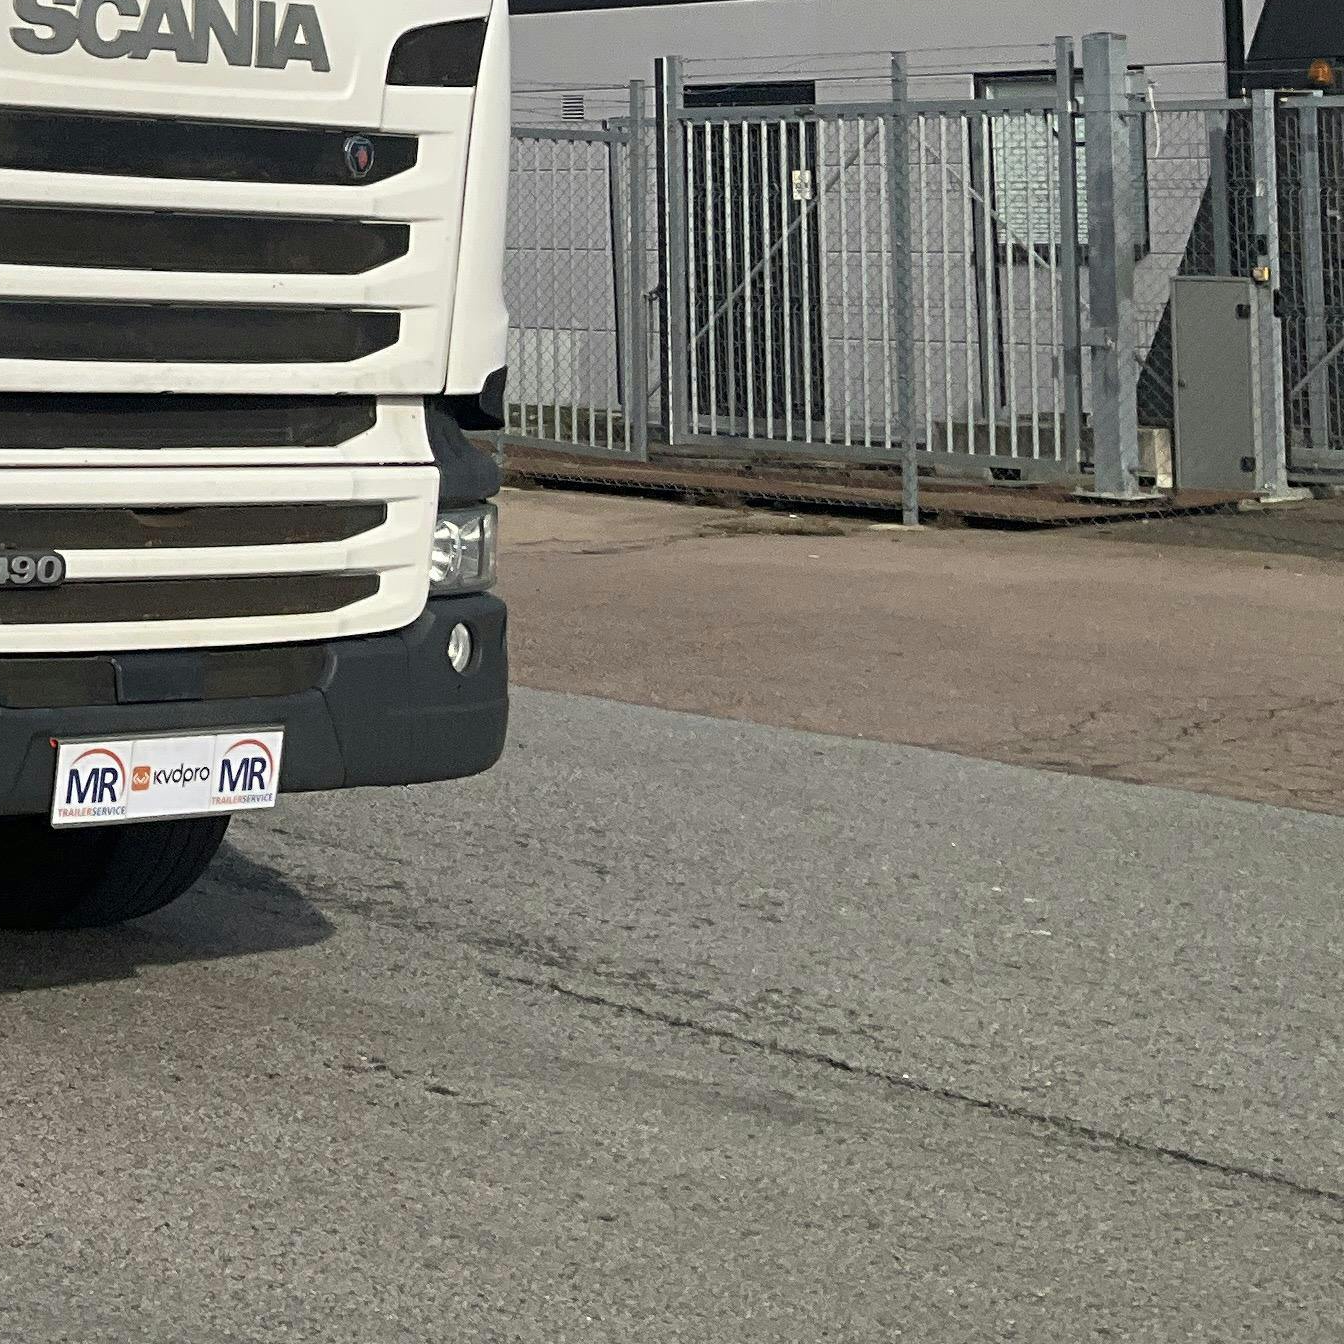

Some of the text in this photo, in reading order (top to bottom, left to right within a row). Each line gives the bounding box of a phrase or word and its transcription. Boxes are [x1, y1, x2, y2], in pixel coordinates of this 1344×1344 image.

[65, 767, 119, 804] MR
[152, 762, 211, 788] kvdpro
[218, 756, 267, 793] MR
